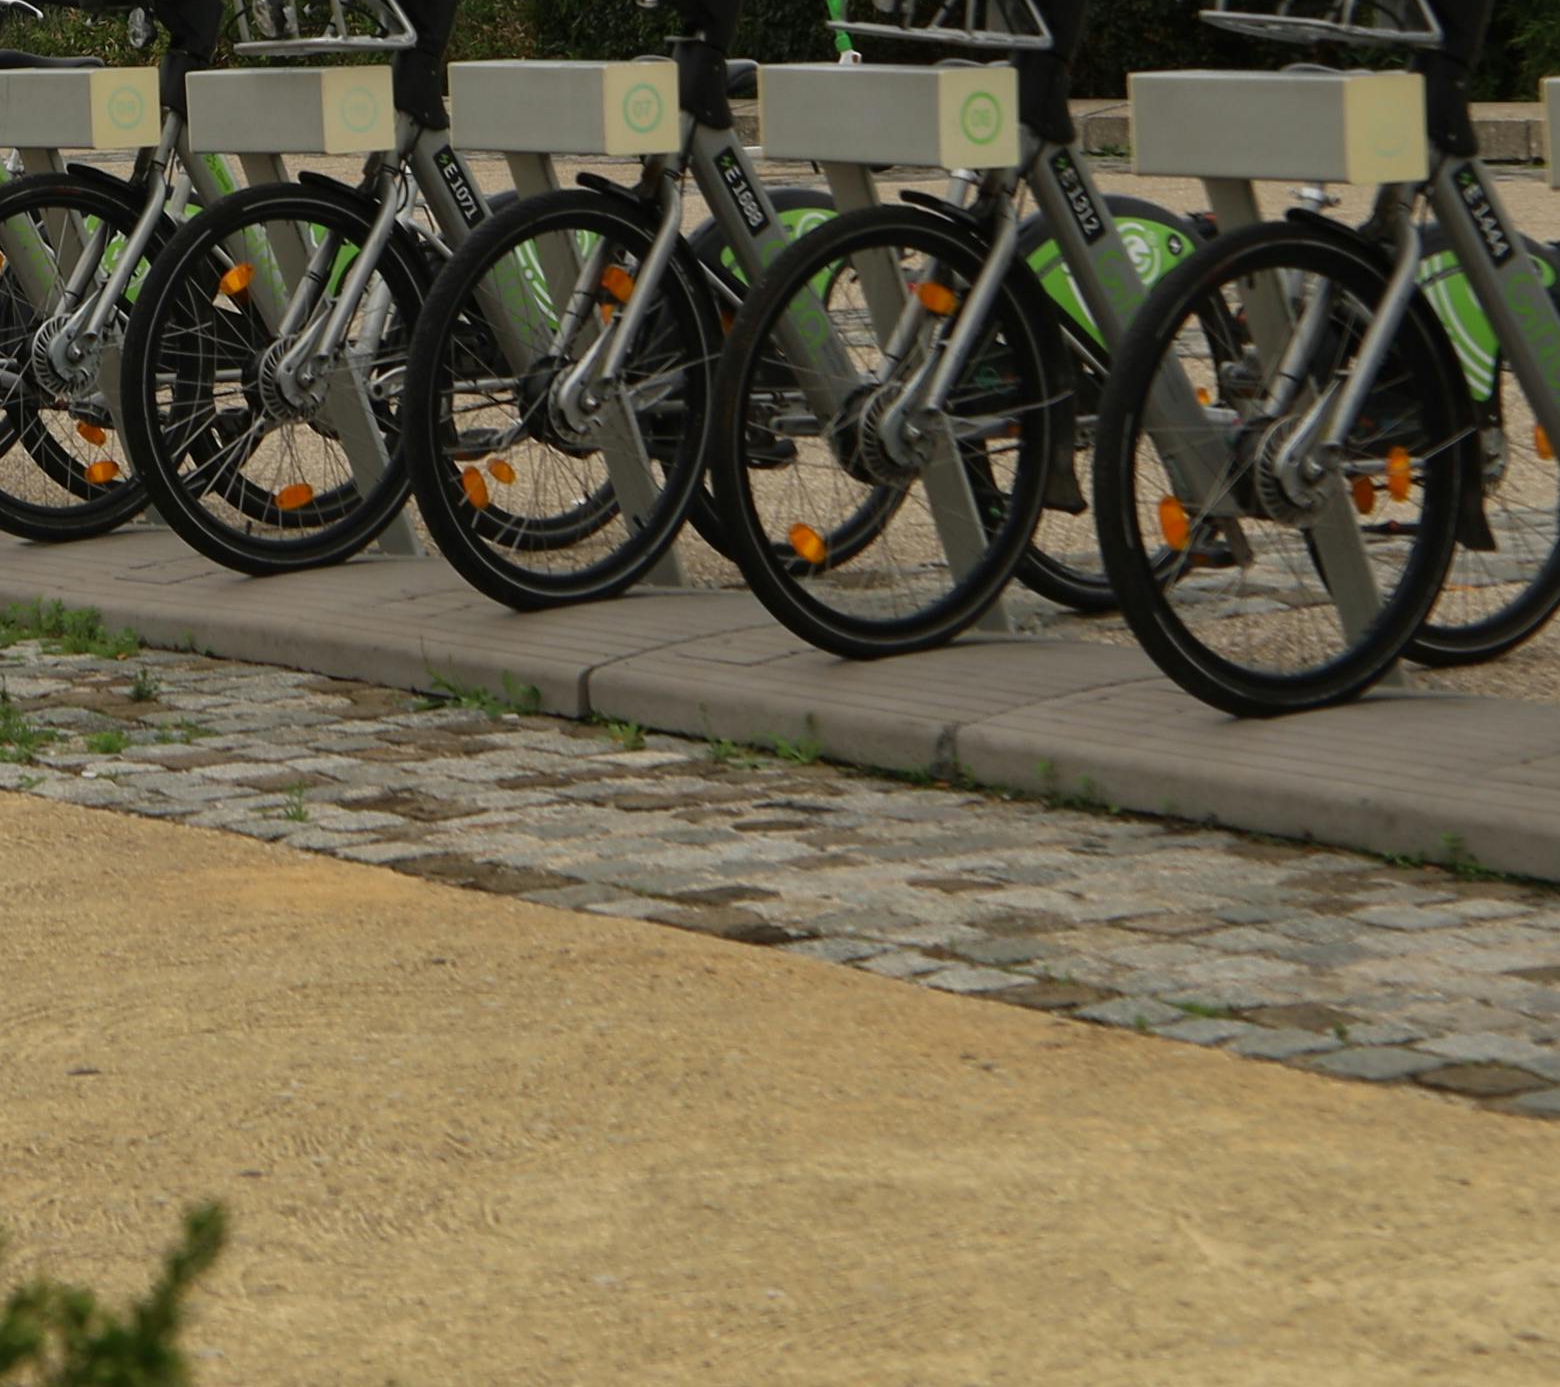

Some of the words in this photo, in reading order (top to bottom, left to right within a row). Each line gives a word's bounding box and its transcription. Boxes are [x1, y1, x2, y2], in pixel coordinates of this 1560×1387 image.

[443, 163, 458, 179] E
[724, 167, 742, 183] E
[450, 179, 478, 220] 1071
[1068, 185, 1101, 235] 1312
[1471, 200, 1510, 258] 1444
